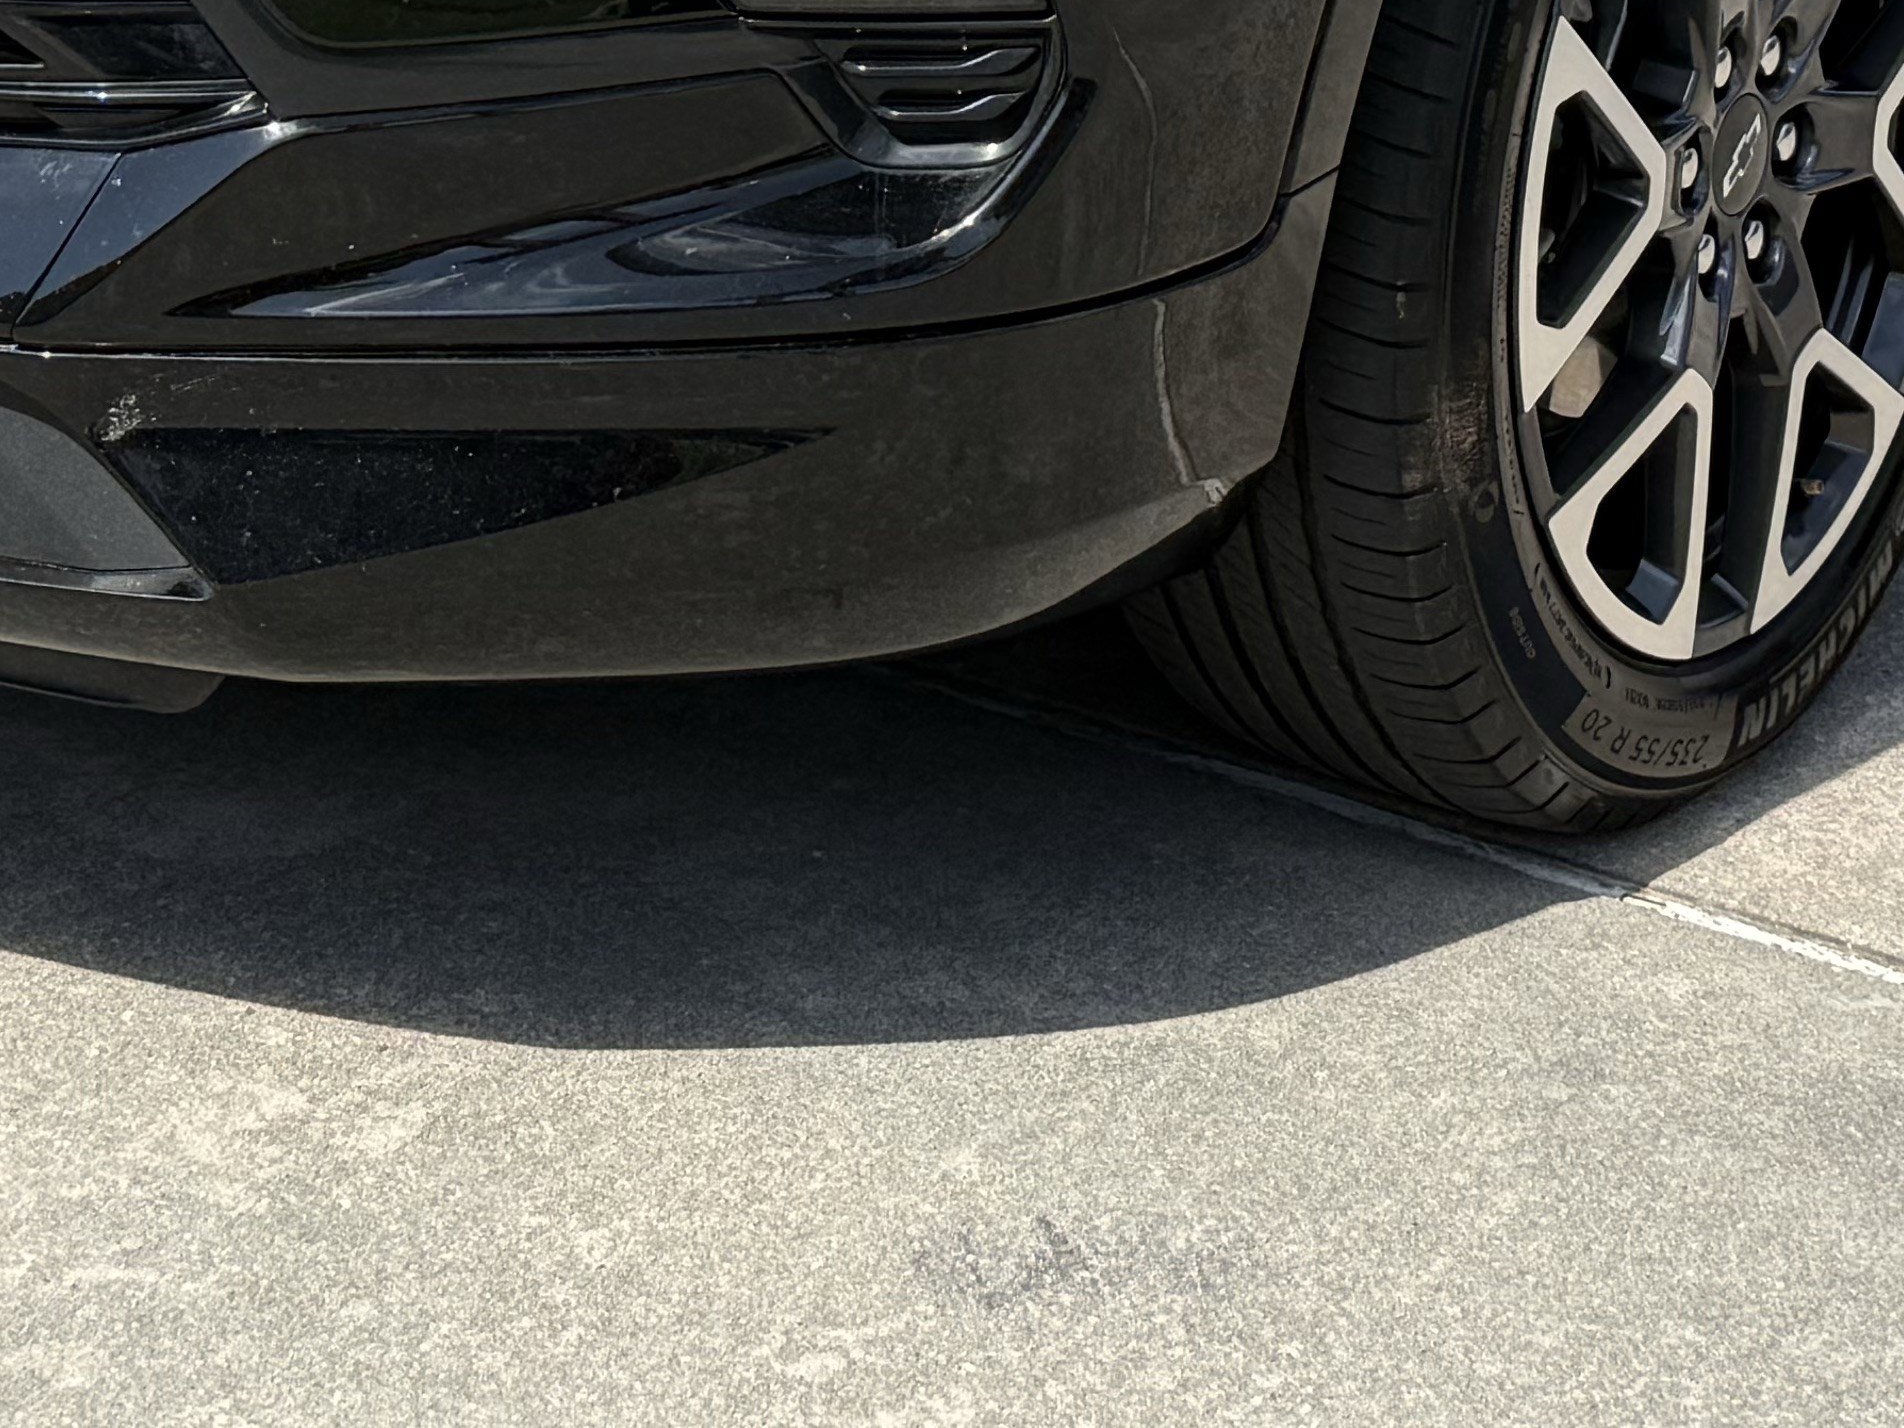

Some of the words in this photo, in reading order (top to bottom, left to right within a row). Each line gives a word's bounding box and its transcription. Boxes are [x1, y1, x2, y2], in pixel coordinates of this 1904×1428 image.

[1580, 708, 1613, 742] 20
[1610, 726, 1632, 755] R
[1628, 733, 1711, 767] 235/55
